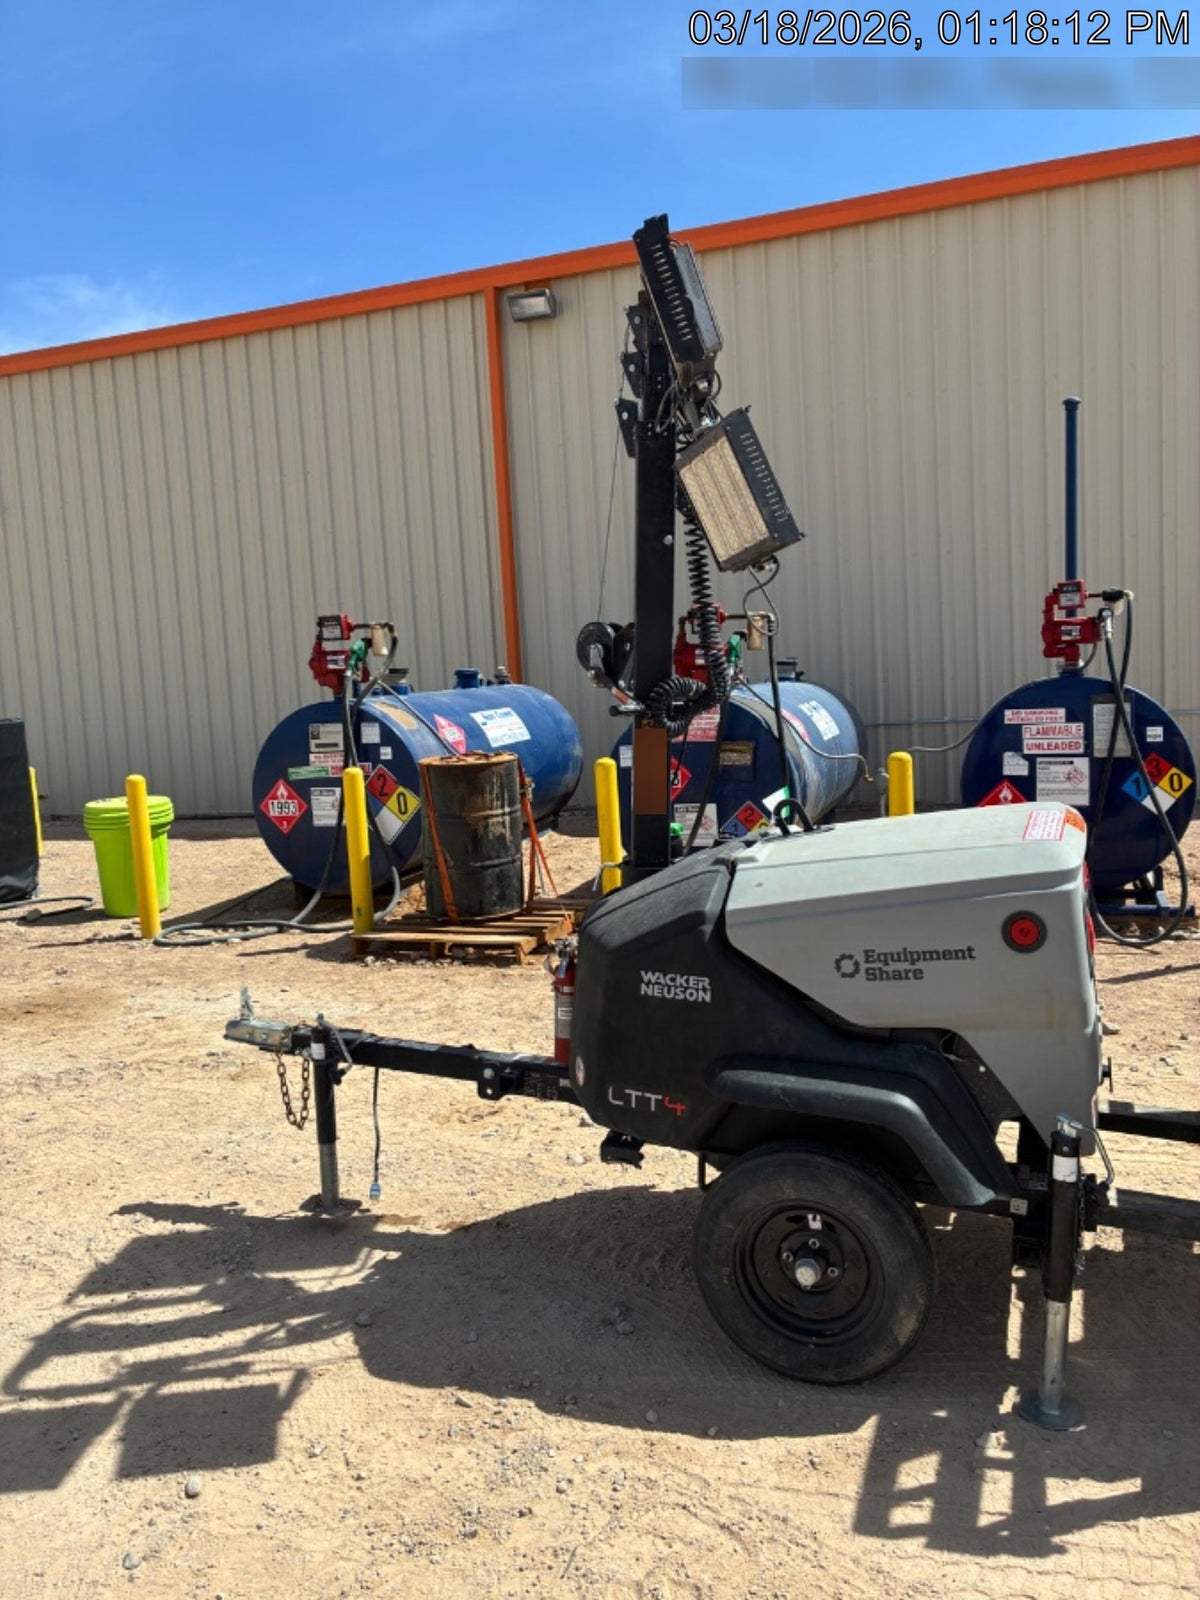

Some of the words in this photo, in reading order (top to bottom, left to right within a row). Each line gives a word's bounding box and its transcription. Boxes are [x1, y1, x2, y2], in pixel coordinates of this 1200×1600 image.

[1023, 724, 1082, 737] FLAMMABLE
[1025, 740, 1082, 751] UNLEADED
[1147, 758, 1162, 777] 3
[376, 773, 388, 797] 2
[1130, 776, 1142, 797] 1
[1168, 772, 1183, 792] 0
[269, 801, 299, 815] 1993
[397, 792, 407, 815] 0
[744, 807, 754, 823] 2
[863, 945, 976, 966] Equipment
[640, 969, 711, 990] WACKER
[864, 967, 924, 981] Share
[640, 982, 712, 1003] NEUSON
[607, 1085, 687, 1116] LTT4
